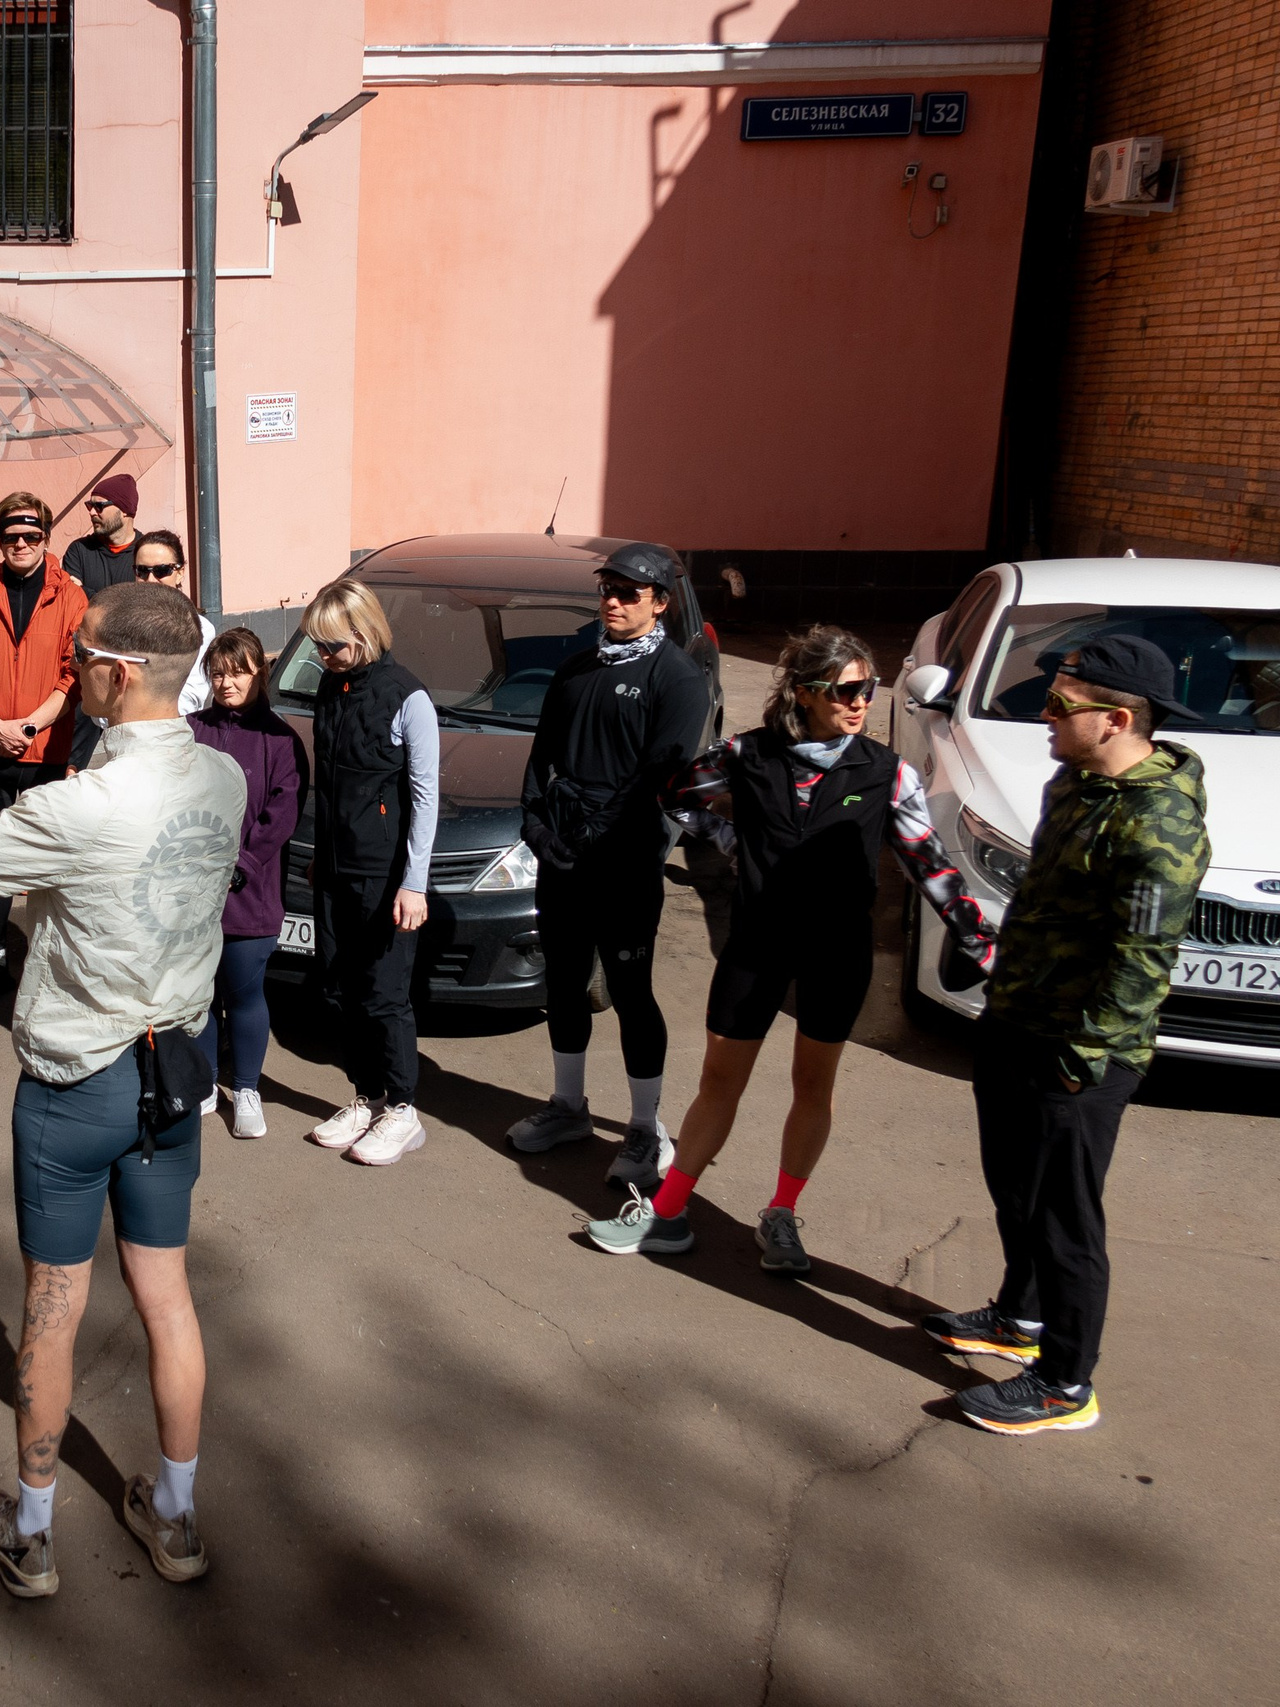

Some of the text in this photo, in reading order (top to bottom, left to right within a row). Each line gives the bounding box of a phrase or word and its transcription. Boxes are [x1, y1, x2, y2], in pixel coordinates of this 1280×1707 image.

[771, 104, 890, 122] СЕЛЕЗНЕВСКАЯ
[931, 103, 960, 123] 32
[810, 122, 846, 131] УЛИЦА
[281, 946, 307, 954] NISSAN
